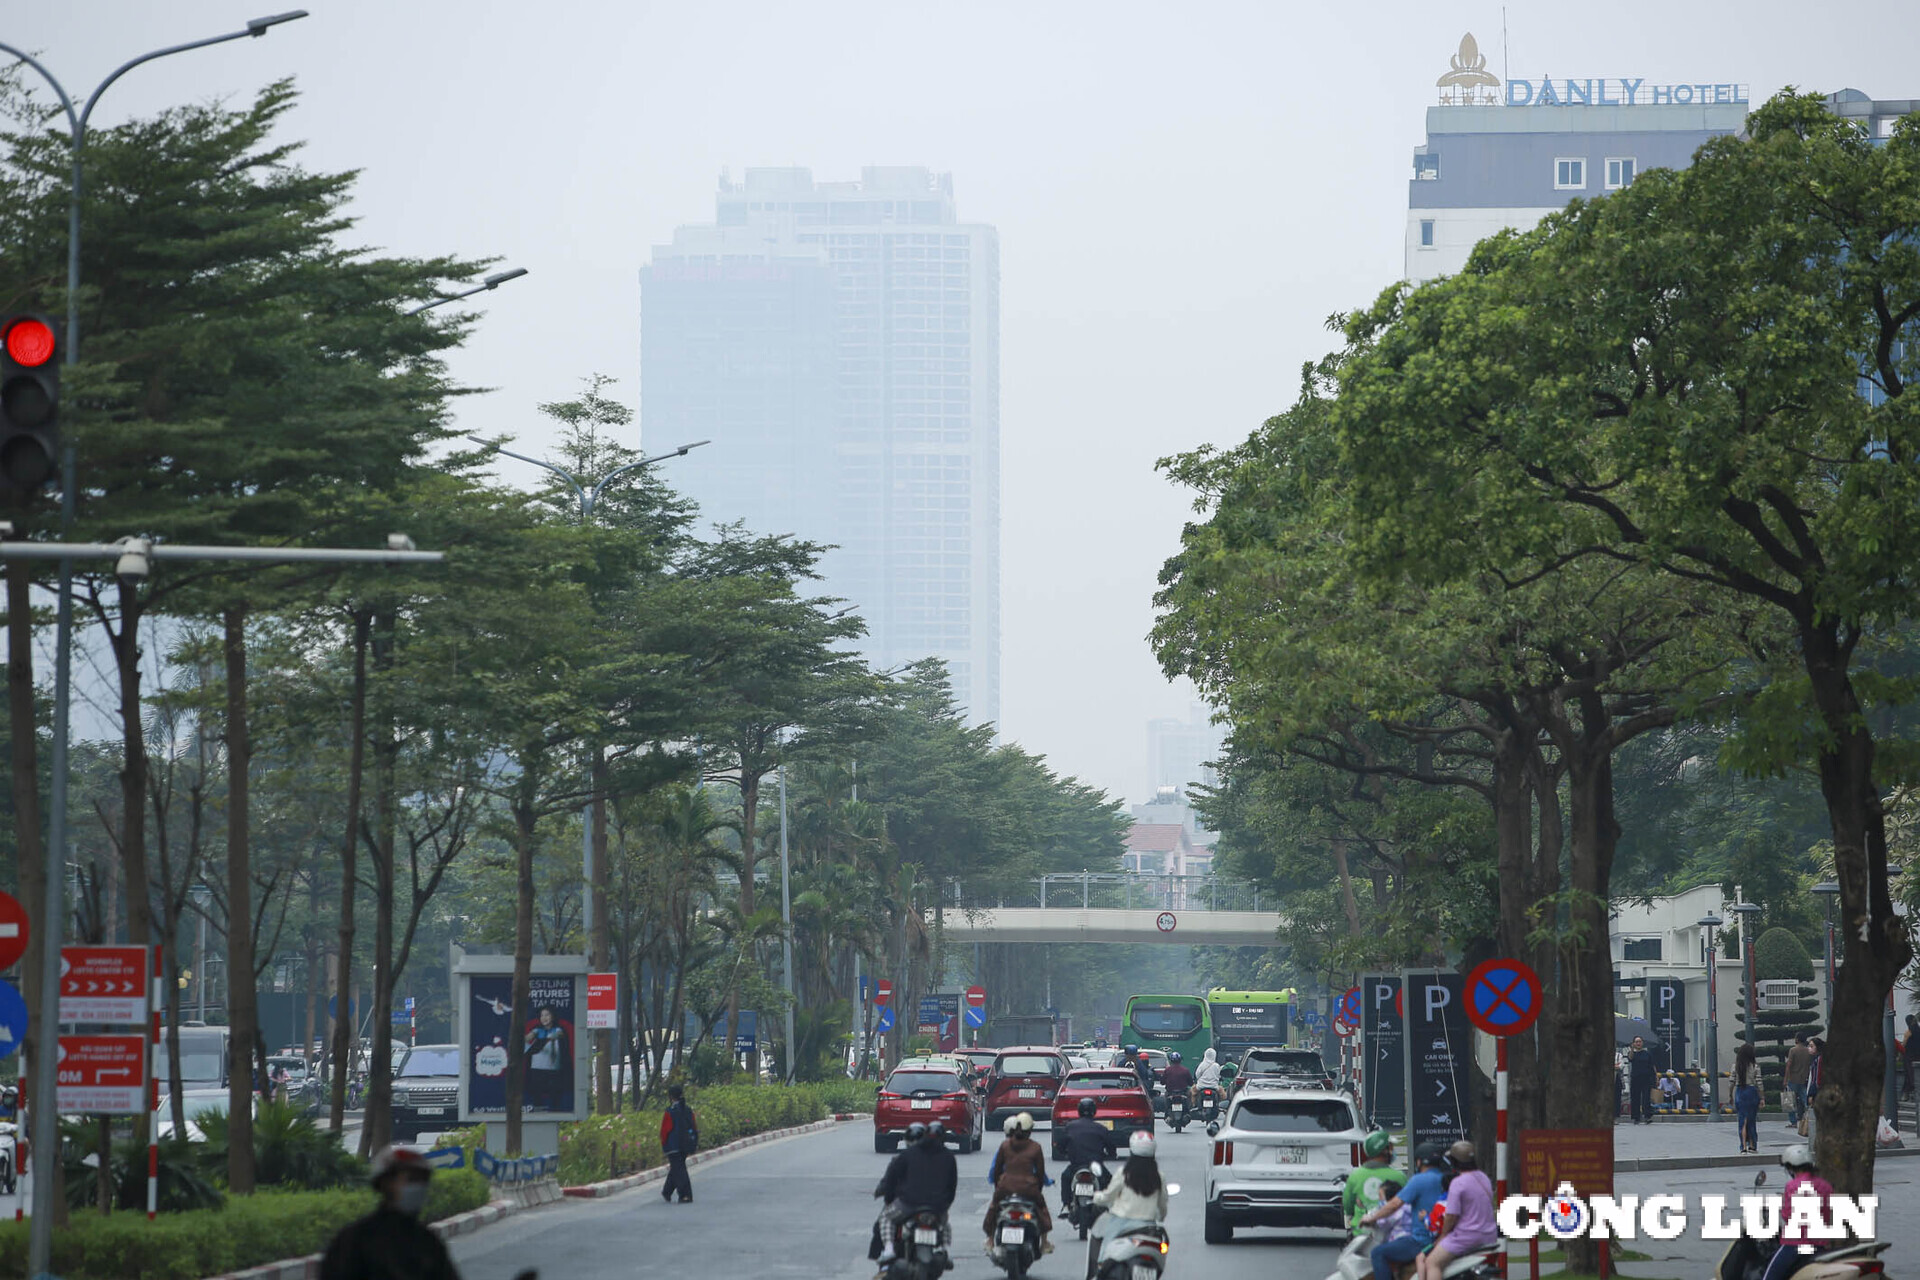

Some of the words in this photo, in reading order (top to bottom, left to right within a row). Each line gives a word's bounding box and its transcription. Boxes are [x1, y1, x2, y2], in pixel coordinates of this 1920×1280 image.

[1507, 78, 1645, 107] DANLY
[1653, 84, 1749, 105] HOTEL
[528, 989, 570, 998] RTURES
[530, 979, 570, 989] ESTLINK
[1375, 984, 1393, 1010] P
[1425, 985, 1451, 1022] P
[1660, 986, 1676, 1009] P
[59, 1070, 82, 1083] 0M
